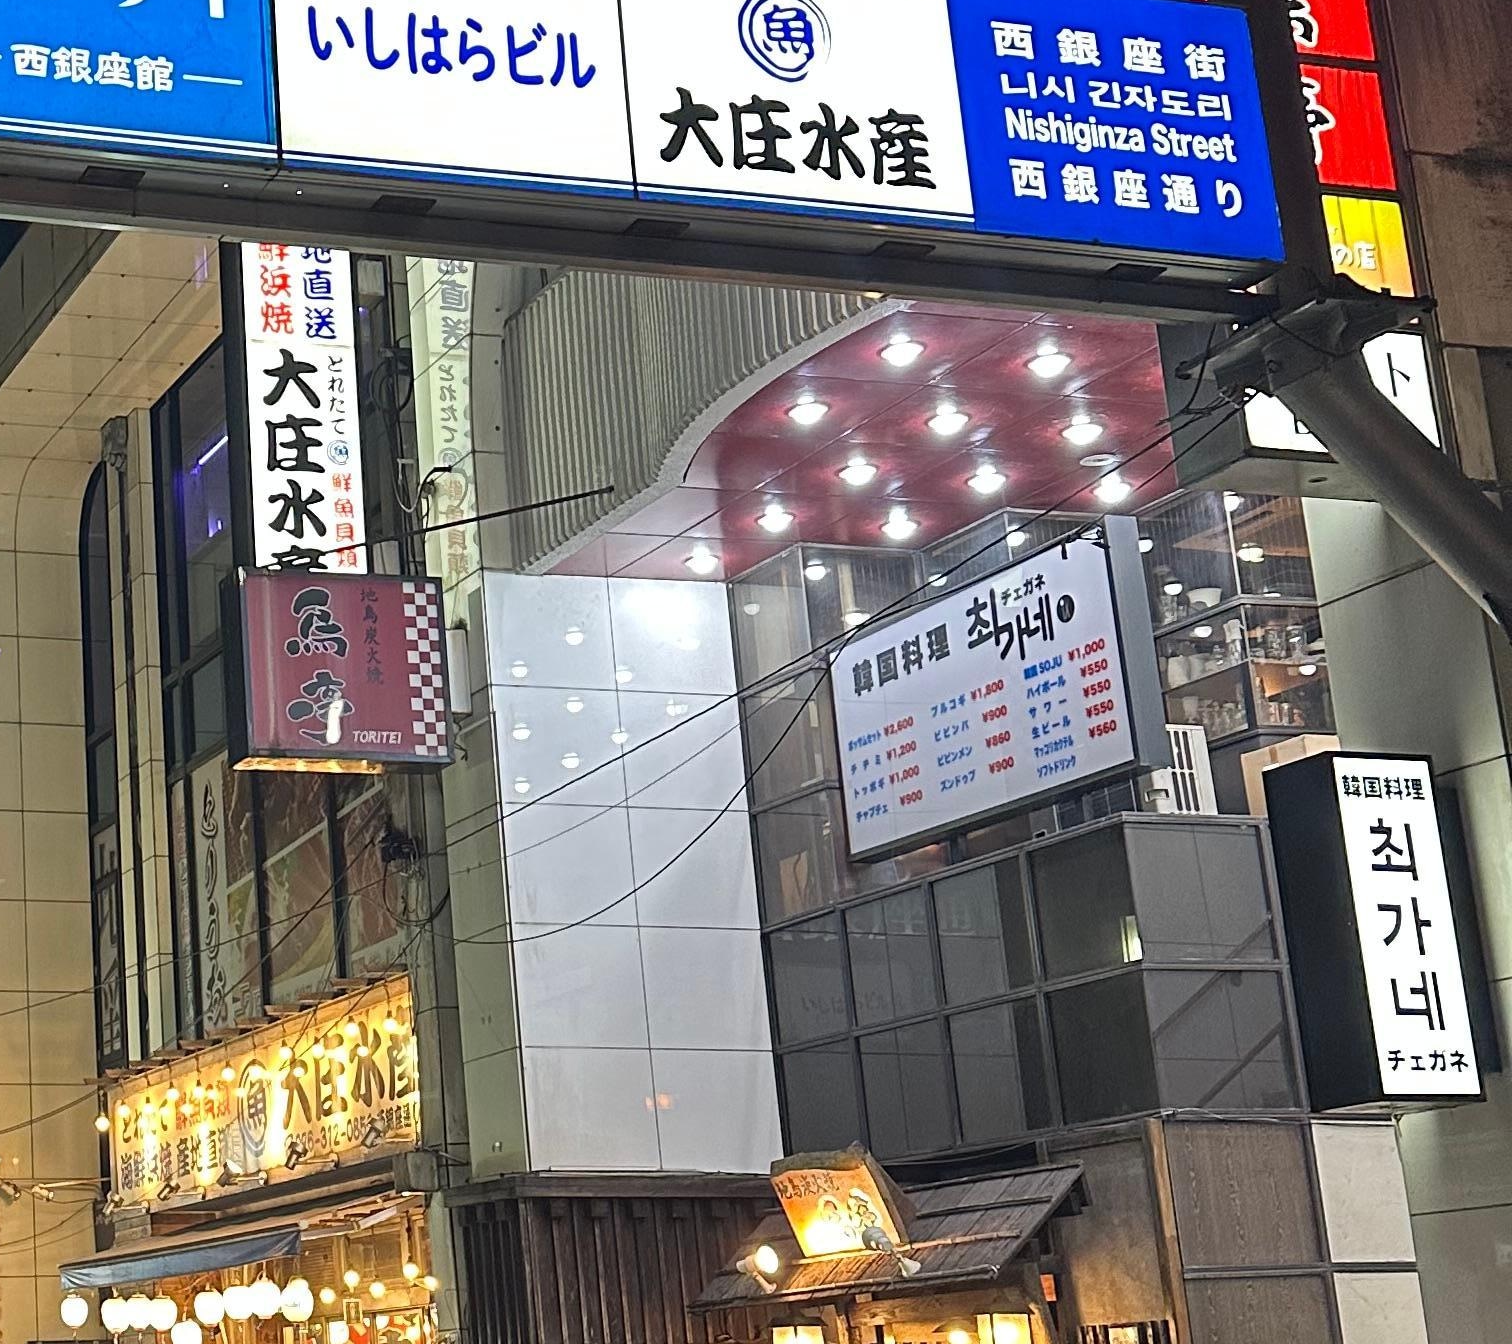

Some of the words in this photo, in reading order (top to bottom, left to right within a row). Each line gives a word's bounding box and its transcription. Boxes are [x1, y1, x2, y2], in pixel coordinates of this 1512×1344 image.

[11, 41, 175, 94] 西銀座館
[306, 3, 597, 92] いしはらビル
[990, 20, 1227, 84] 西銀座街
[1000, 72, 1077, 105] 니시
[1086, 78, 1234, 123] 긴자도리
[659, 86, 938, 191] 大庄水産
[1004, 109, 1146, 156] Nishiginza
[1151, 125, 1237, 164] Street
[1008, 157, 1245, 220] 西銀座通り
[327, 355, 346, 436] とれたて
[1000, 573, 1047, 606] チェガネ
[852, 623, 950, 697] 韓国料理
[352, 730, 402, 745] TORITEI
[1341, 774, 1426, 801] 韓国料理
[1369, 817, 1447, 1032] 최가네
[1387, 1049, 1469, 1073] チェガネ
